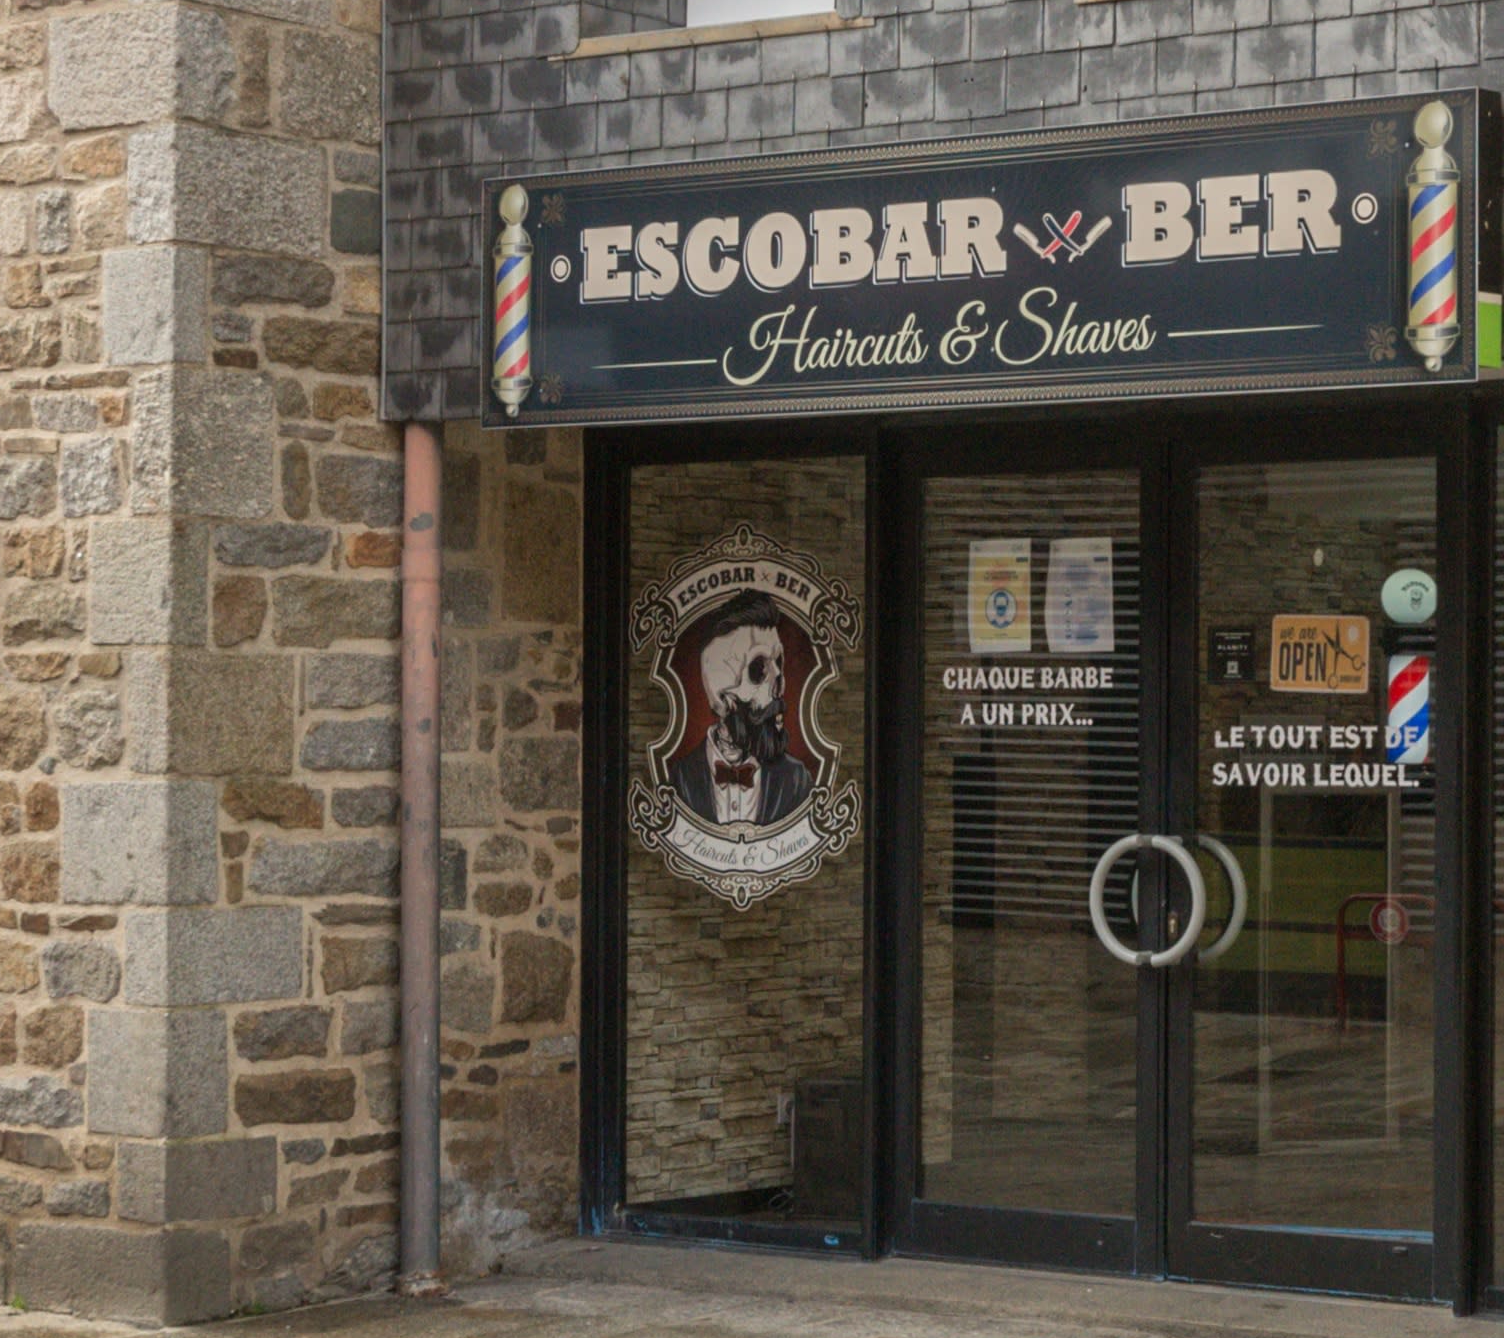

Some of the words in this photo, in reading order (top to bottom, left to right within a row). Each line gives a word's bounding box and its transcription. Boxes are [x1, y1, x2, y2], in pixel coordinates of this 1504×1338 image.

[580, 198, 1007, 304] ESCOBAR
[1122, 170, 1341, 268] BER
[723, 304, 928, 386] Haircuts
[939, 300, 989, 365] &
[996, 286, 1156, 366] Shaves
[676, 566, 755, 607] ESCOBAR
[775, 573, 811, 601] BER
[1280, 627, 1294, 640] we
[1298, 627, 1318, 640] are
[1279, 642, 1326, 682] OPEN
[943, 667, 1035, 689] CHAQUE
[1040, 667, 1113, 689] BARBE
[960, 704, 975, 725] A
[982, 703, 1014, 725] UN
[1021, 703, 1094, 725] PRIX...
[1215, 725, 1244, 748] LE
[1251, 725, 1322, 748] TOUT
[1330, 726, 1377, 748] EST
[1385, 726, 1419, 748] DE
[1212, 763, 1306, 786] SAVOIR
[1313, 763, 1420, 787] LEQUEL.
[672, 827, 737, 865] Haircuts
[742, 847, 756, 866] &
[759, 834, 809, 866] Shaves
